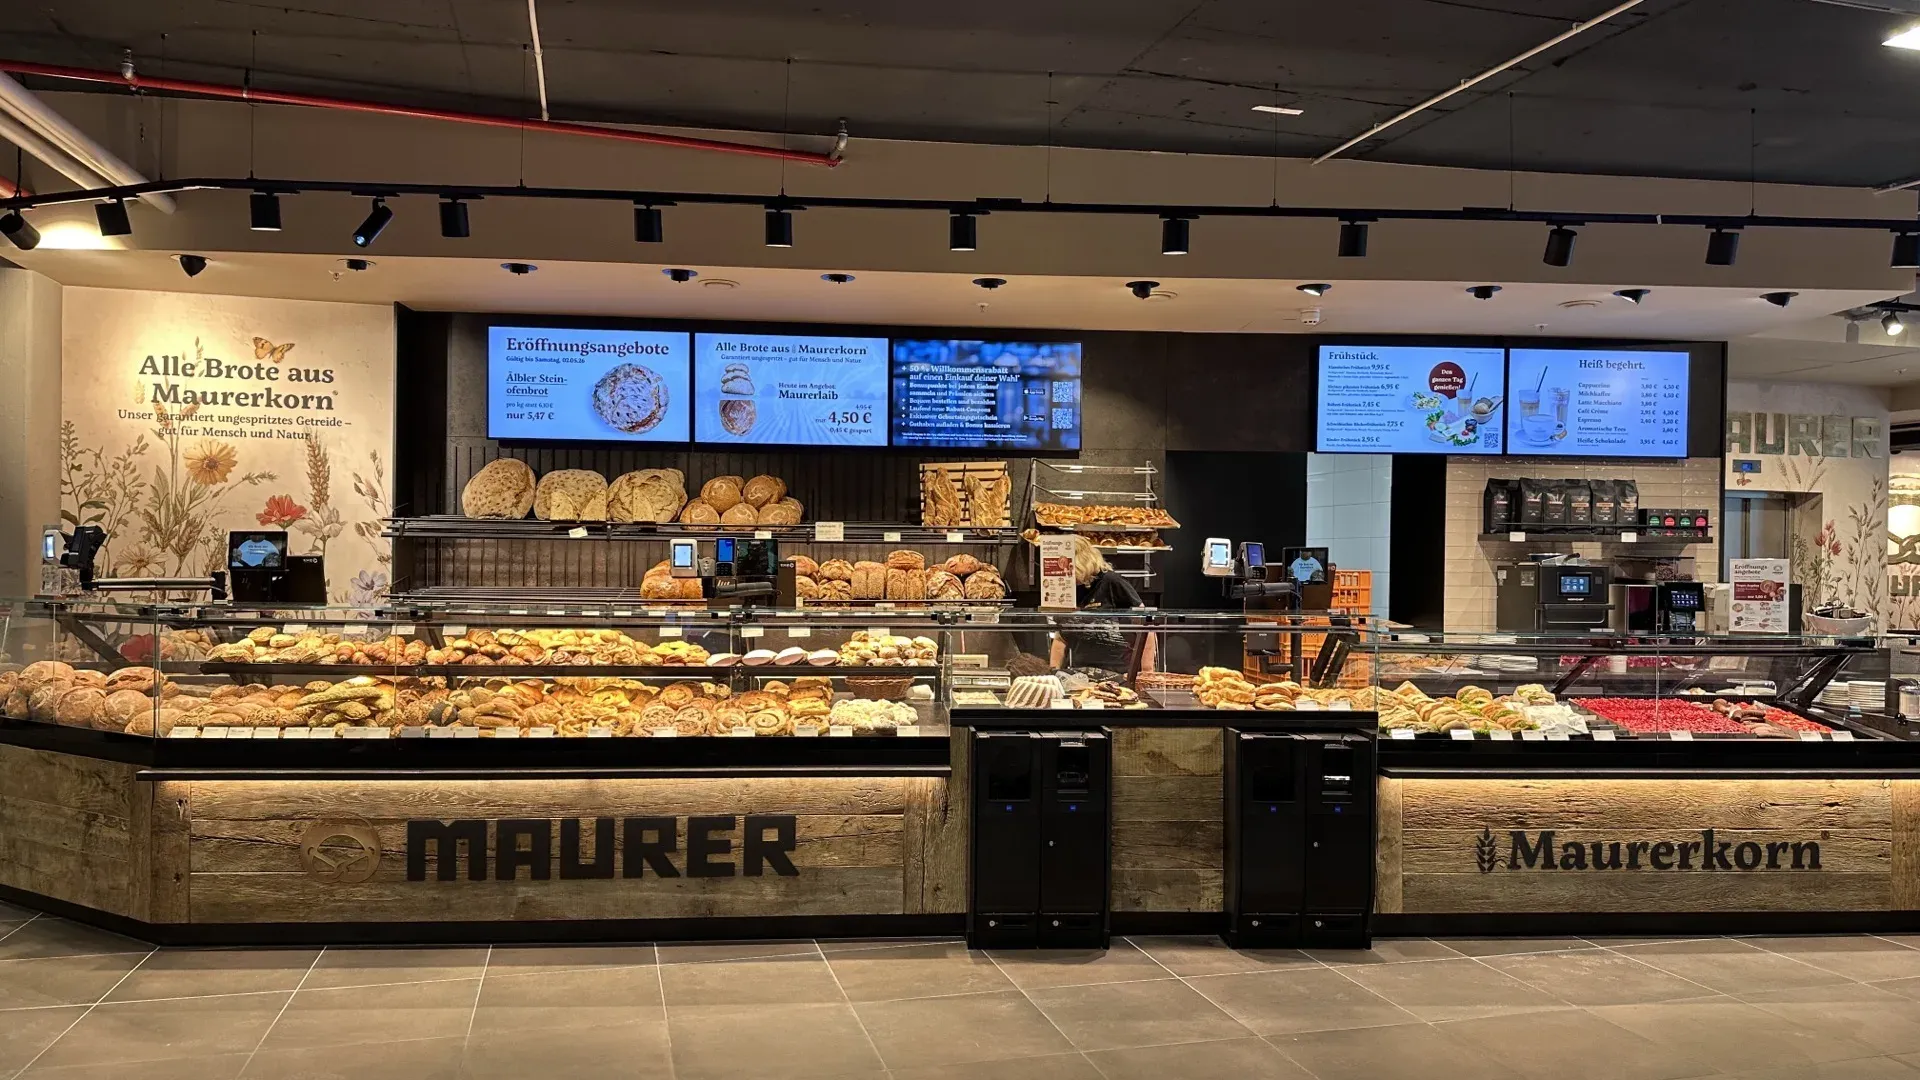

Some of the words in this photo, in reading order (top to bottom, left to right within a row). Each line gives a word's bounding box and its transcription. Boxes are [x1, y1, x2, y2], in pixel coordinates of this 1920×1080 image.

[506, 337, 670, 357] Eröffnungsangebote
[715, 342, 738, 352] Alle
[740, 342, 769, 353] Brote
[771, 345, 790, 354] aus
[139, 355, 195, 377] Alle
[204, 358, 279, 381] Brote
[288, 367, 334, 383] aus
[930, 365, 1008, 374] Willkommensrabatt
[1579, 360, 1603, 369] Heiß
[1606, 360, 1646, 371] begehrt.
[506, 370, 536, 382] Älbler
[539, 374, 568, 383] Stein-
[944, 374, 974, 382] Einkauf
[506, 385, 548, 395] ofenbrot
[778, 389, 838, 400] Maurerlaib
[118, 409, 153, 420] Unser
[156, 411, 214, 423] garantiert
[218, 414, 293, 426] ungespritztes
[296, 416, 343, 427] Getreide
[527, 411, 546, 421] 5,47
[548, 412, 555, 420] €
[828, 411, 859, 426] 4,50
[862, 412, 872, 424] €
[158, 426, 177, 437] gut
[180, 426, 199, 436] für
[202, 427, 247, 438] Mensch
[250, 429, 273, 439] und
[276, 430, 312, 440] Natur
[1726, 412, 1882, 458] AURER
[407, 815, 799, 881] MAURER
